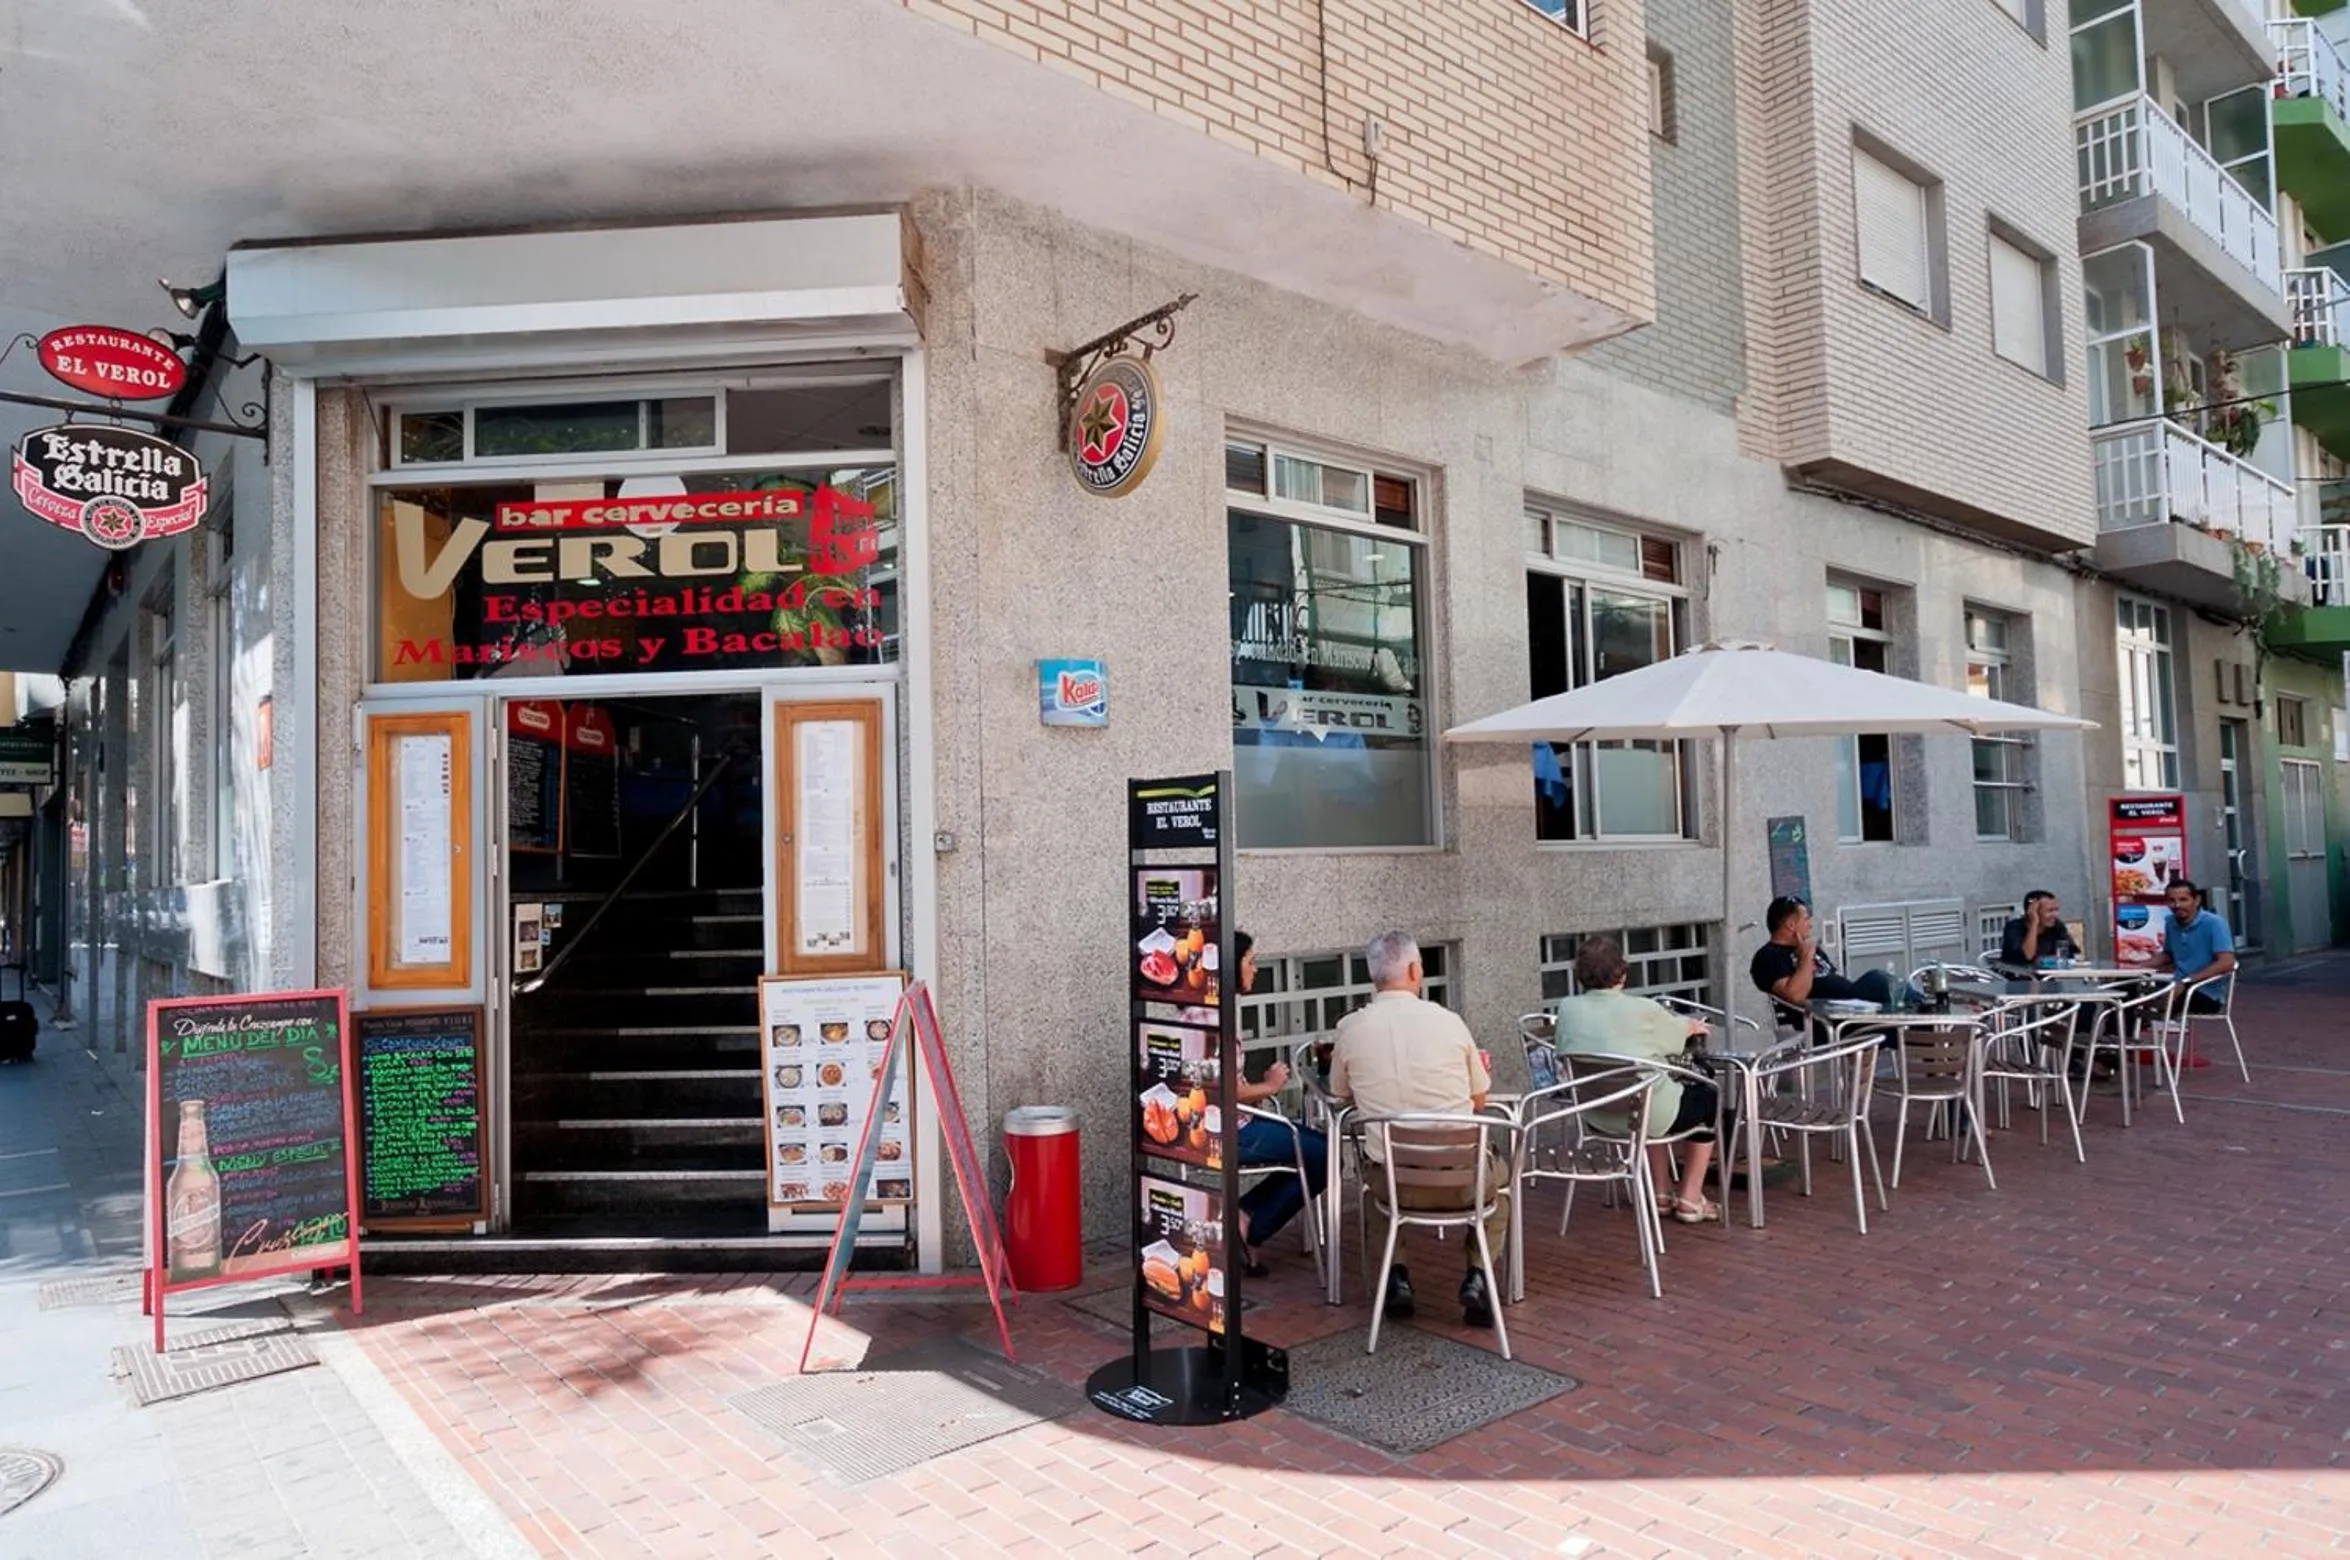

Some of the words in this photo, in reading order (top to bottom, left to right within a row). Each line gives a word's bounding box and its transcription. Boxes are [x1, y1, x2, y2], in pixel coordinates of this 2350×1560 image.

[51, 333, 176, 372] RESTAURANTE
[56, 355, 88, 376] EL
[95, 361, 171, 389] VEROL
[42, 433, 183, 478] Estrella
[53, 463, 169, 501] Galicia
[502, 505, 572, 528] bar
[582, 494, 798, 525] cervecería
[393, 500, 804, 600] VEROL
[484, 582, 804, 628] Especialidad
[822, 587, 882, 609] en
[394, 630, 620, 665] Mariscos
[639, 635, 666, 665] y
[682, 622, 883, 656] Bacalao
[1256, 691, 1394, 729] VEROL
[1146, 799, 1212, 815] RESTAURANTE
[1156, 816, 1168, 829] EL
[1171, 814, 1202, 828] VEROL
[247, 1030, 280, 1046] DEL
